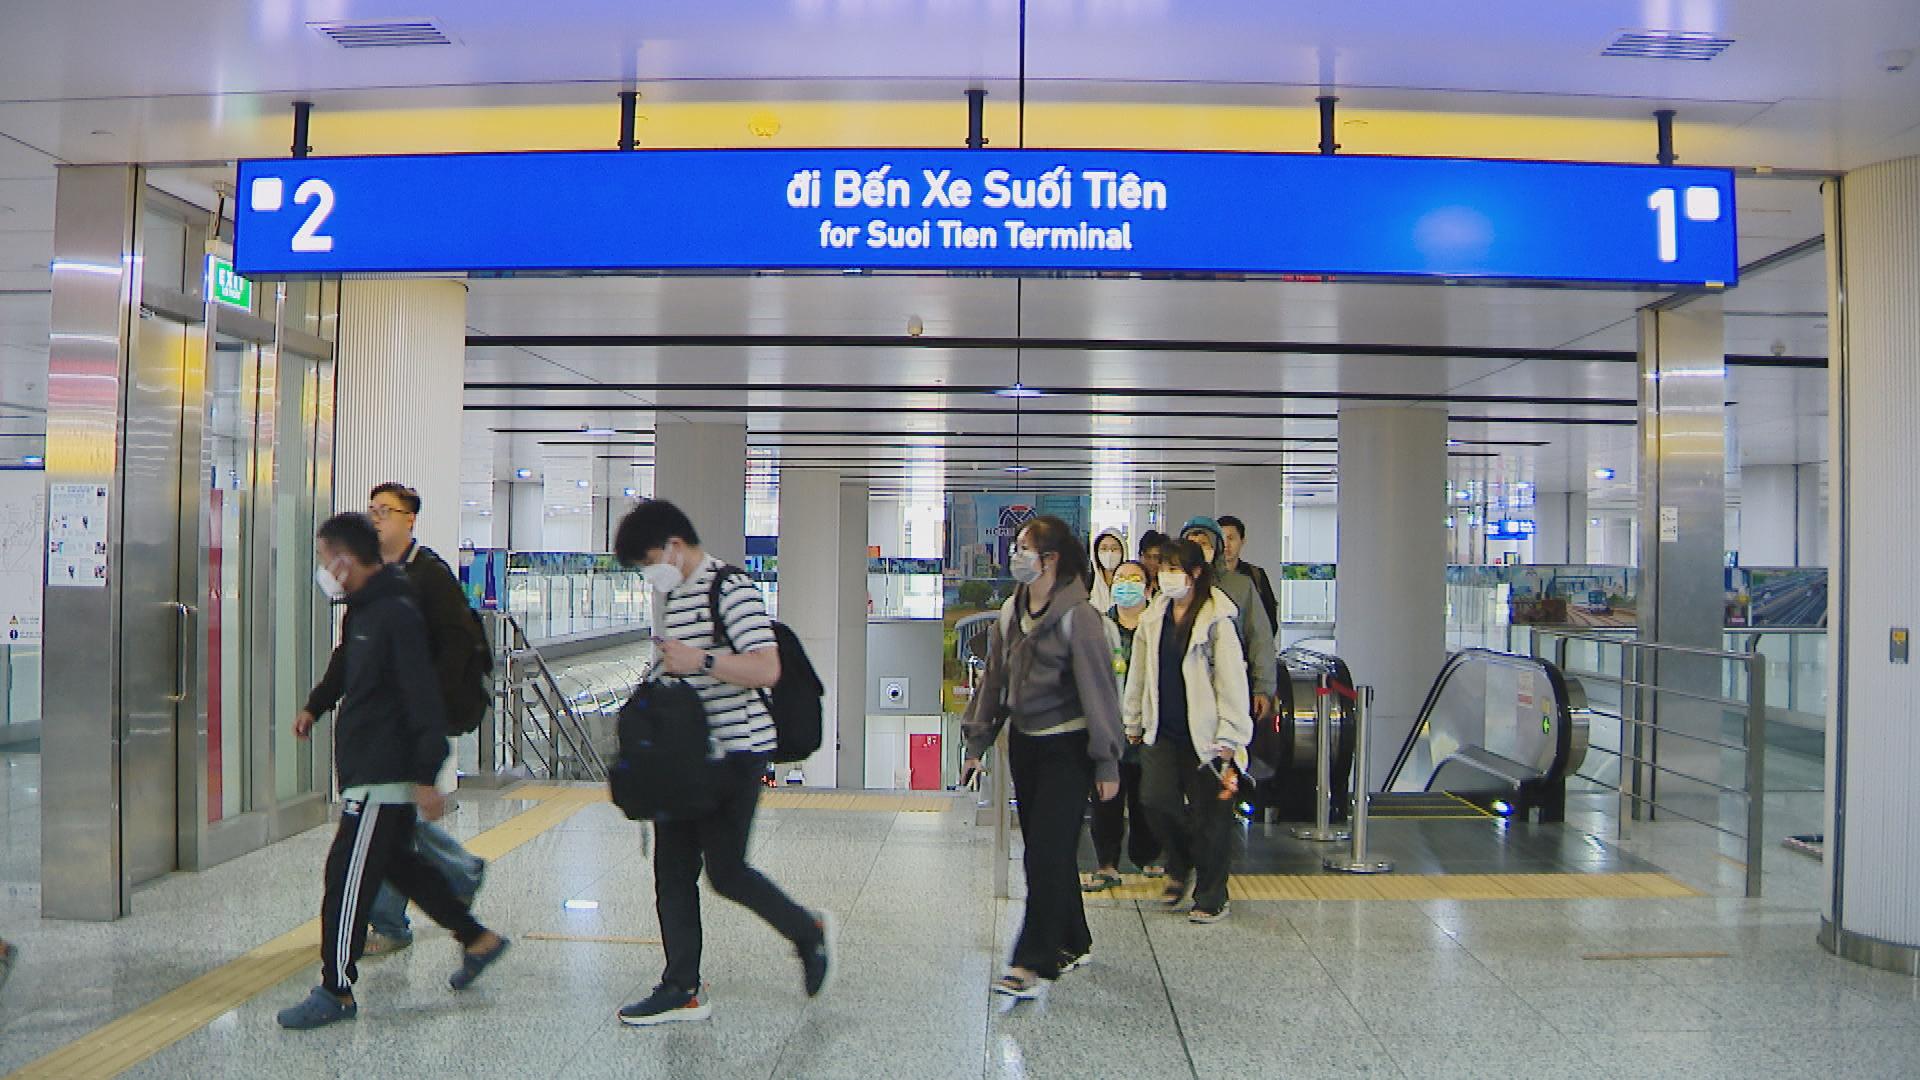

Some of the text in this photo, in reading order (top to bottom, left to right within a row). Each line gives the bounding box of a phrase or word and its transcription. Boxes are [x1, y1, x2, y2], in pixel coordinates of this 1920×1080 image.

[290, 179, 335, 253] 2
[786, 164, 1168, 211] đi Bến Xe Suối Tiên
[820, 219, 1133, 251] for Suoi Tien Terminal
[1648, 187, 1677, 263] 1
